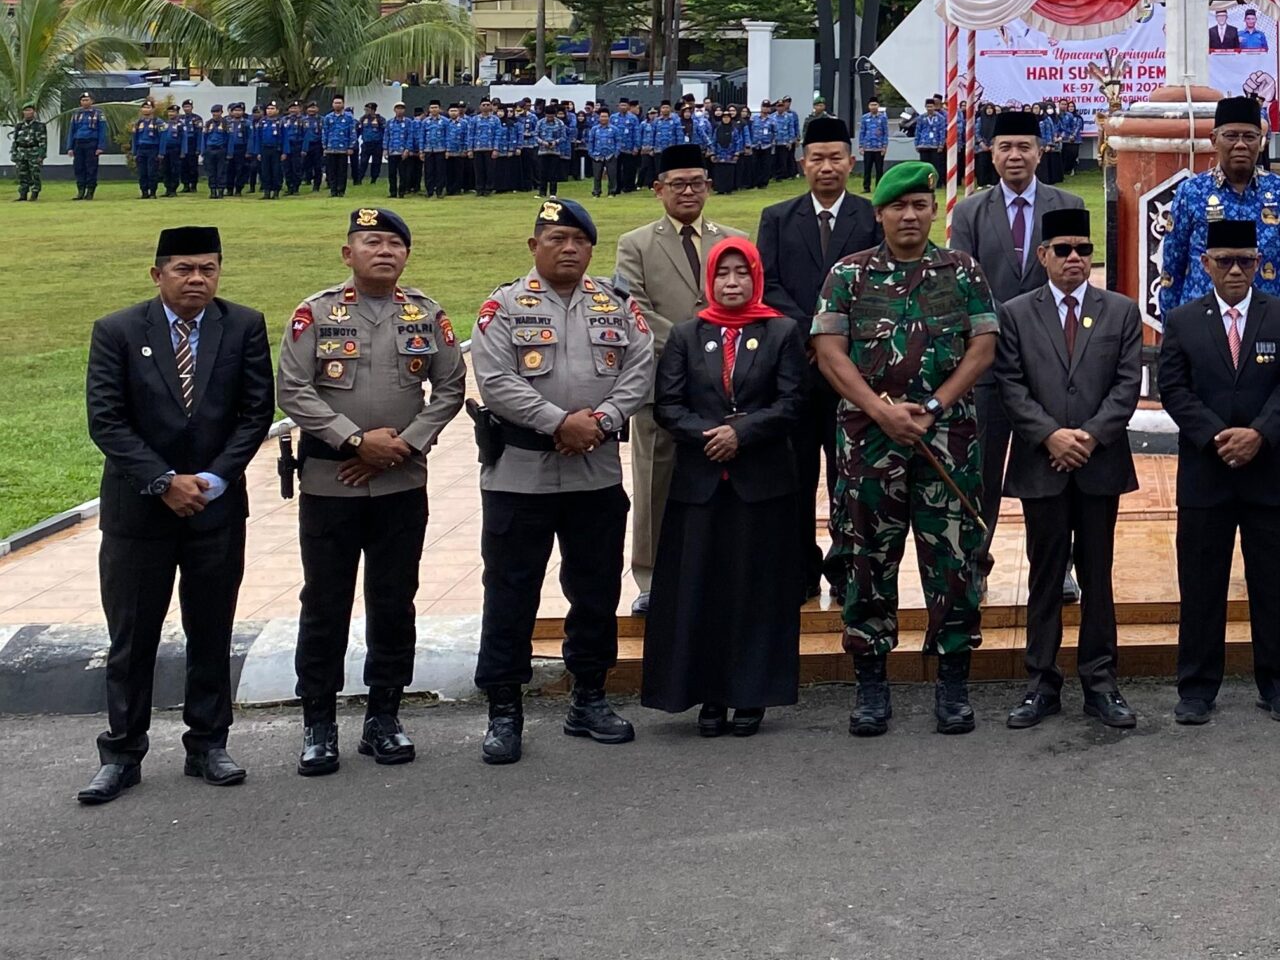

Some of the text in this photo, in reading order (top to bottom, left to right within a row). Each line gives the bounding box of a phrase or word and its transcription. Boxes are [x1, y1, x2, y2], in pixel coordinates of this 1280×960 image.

[1053, 47, 1103, 64] Upacara
[1107, 47, 1166, 64] Peringata
[1027, 66, 1166, 80] HARI SUPH PEM
[1063, 83, 1094, 93] KE-97
[589, 316, 623, 327] POLRI
[319, 327, 357, 337] SISWOYO
[397, 323, 432, 335] POLRI
